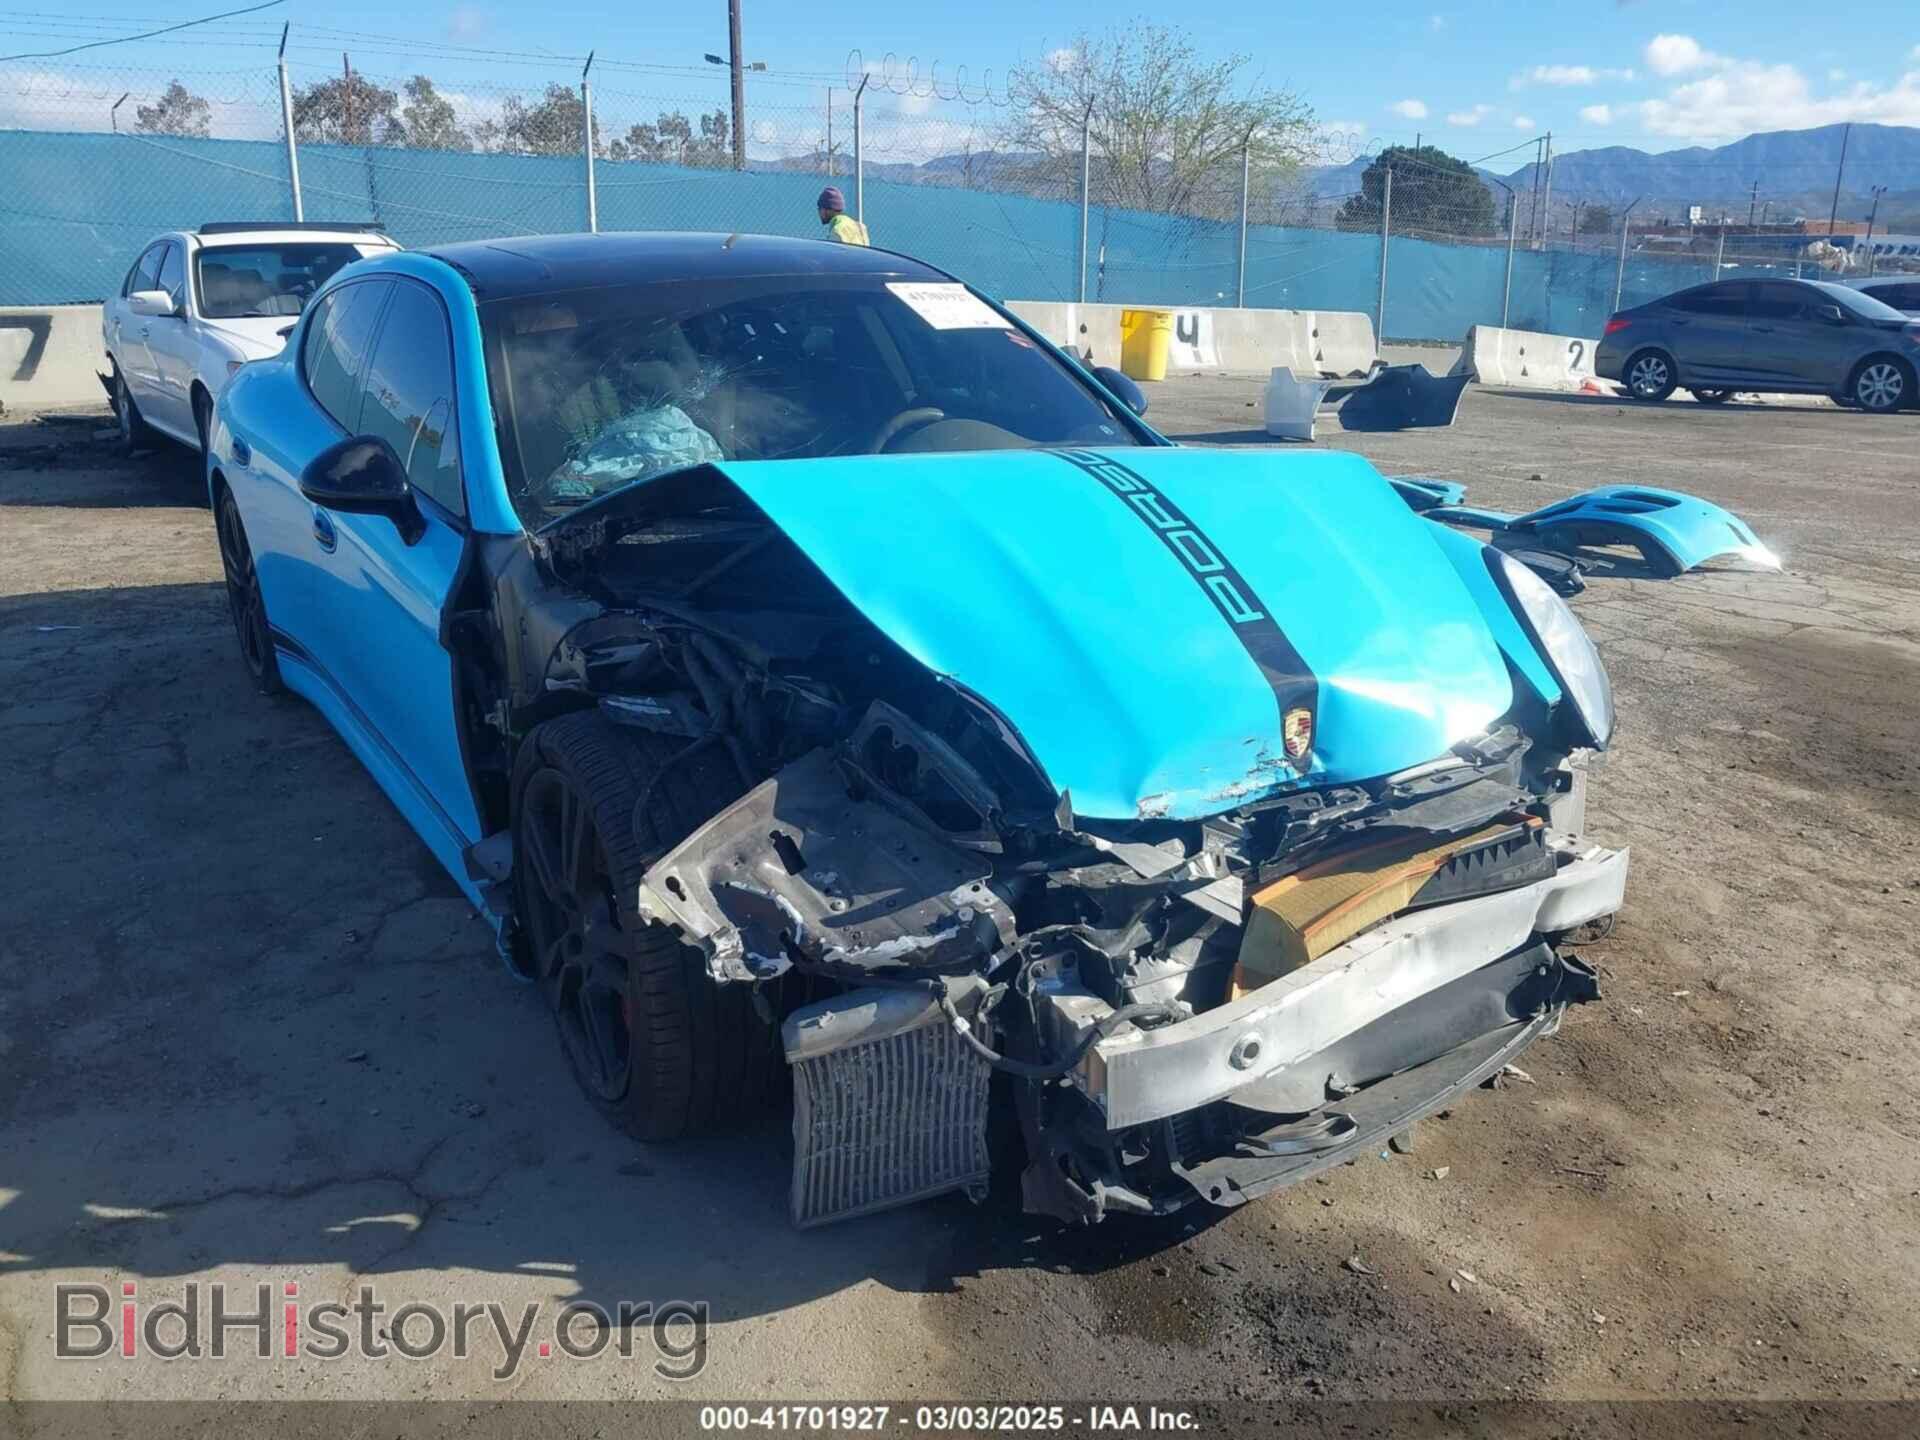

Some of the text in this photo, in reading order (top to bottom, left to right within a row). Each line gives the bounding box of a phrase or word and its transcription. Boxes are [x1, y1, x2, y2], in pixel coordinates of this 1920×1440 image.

[0, 315, 53, 381] 7
[1177, 314, 1201, 362] 4
[1568, 340, 1585, 373] 2
